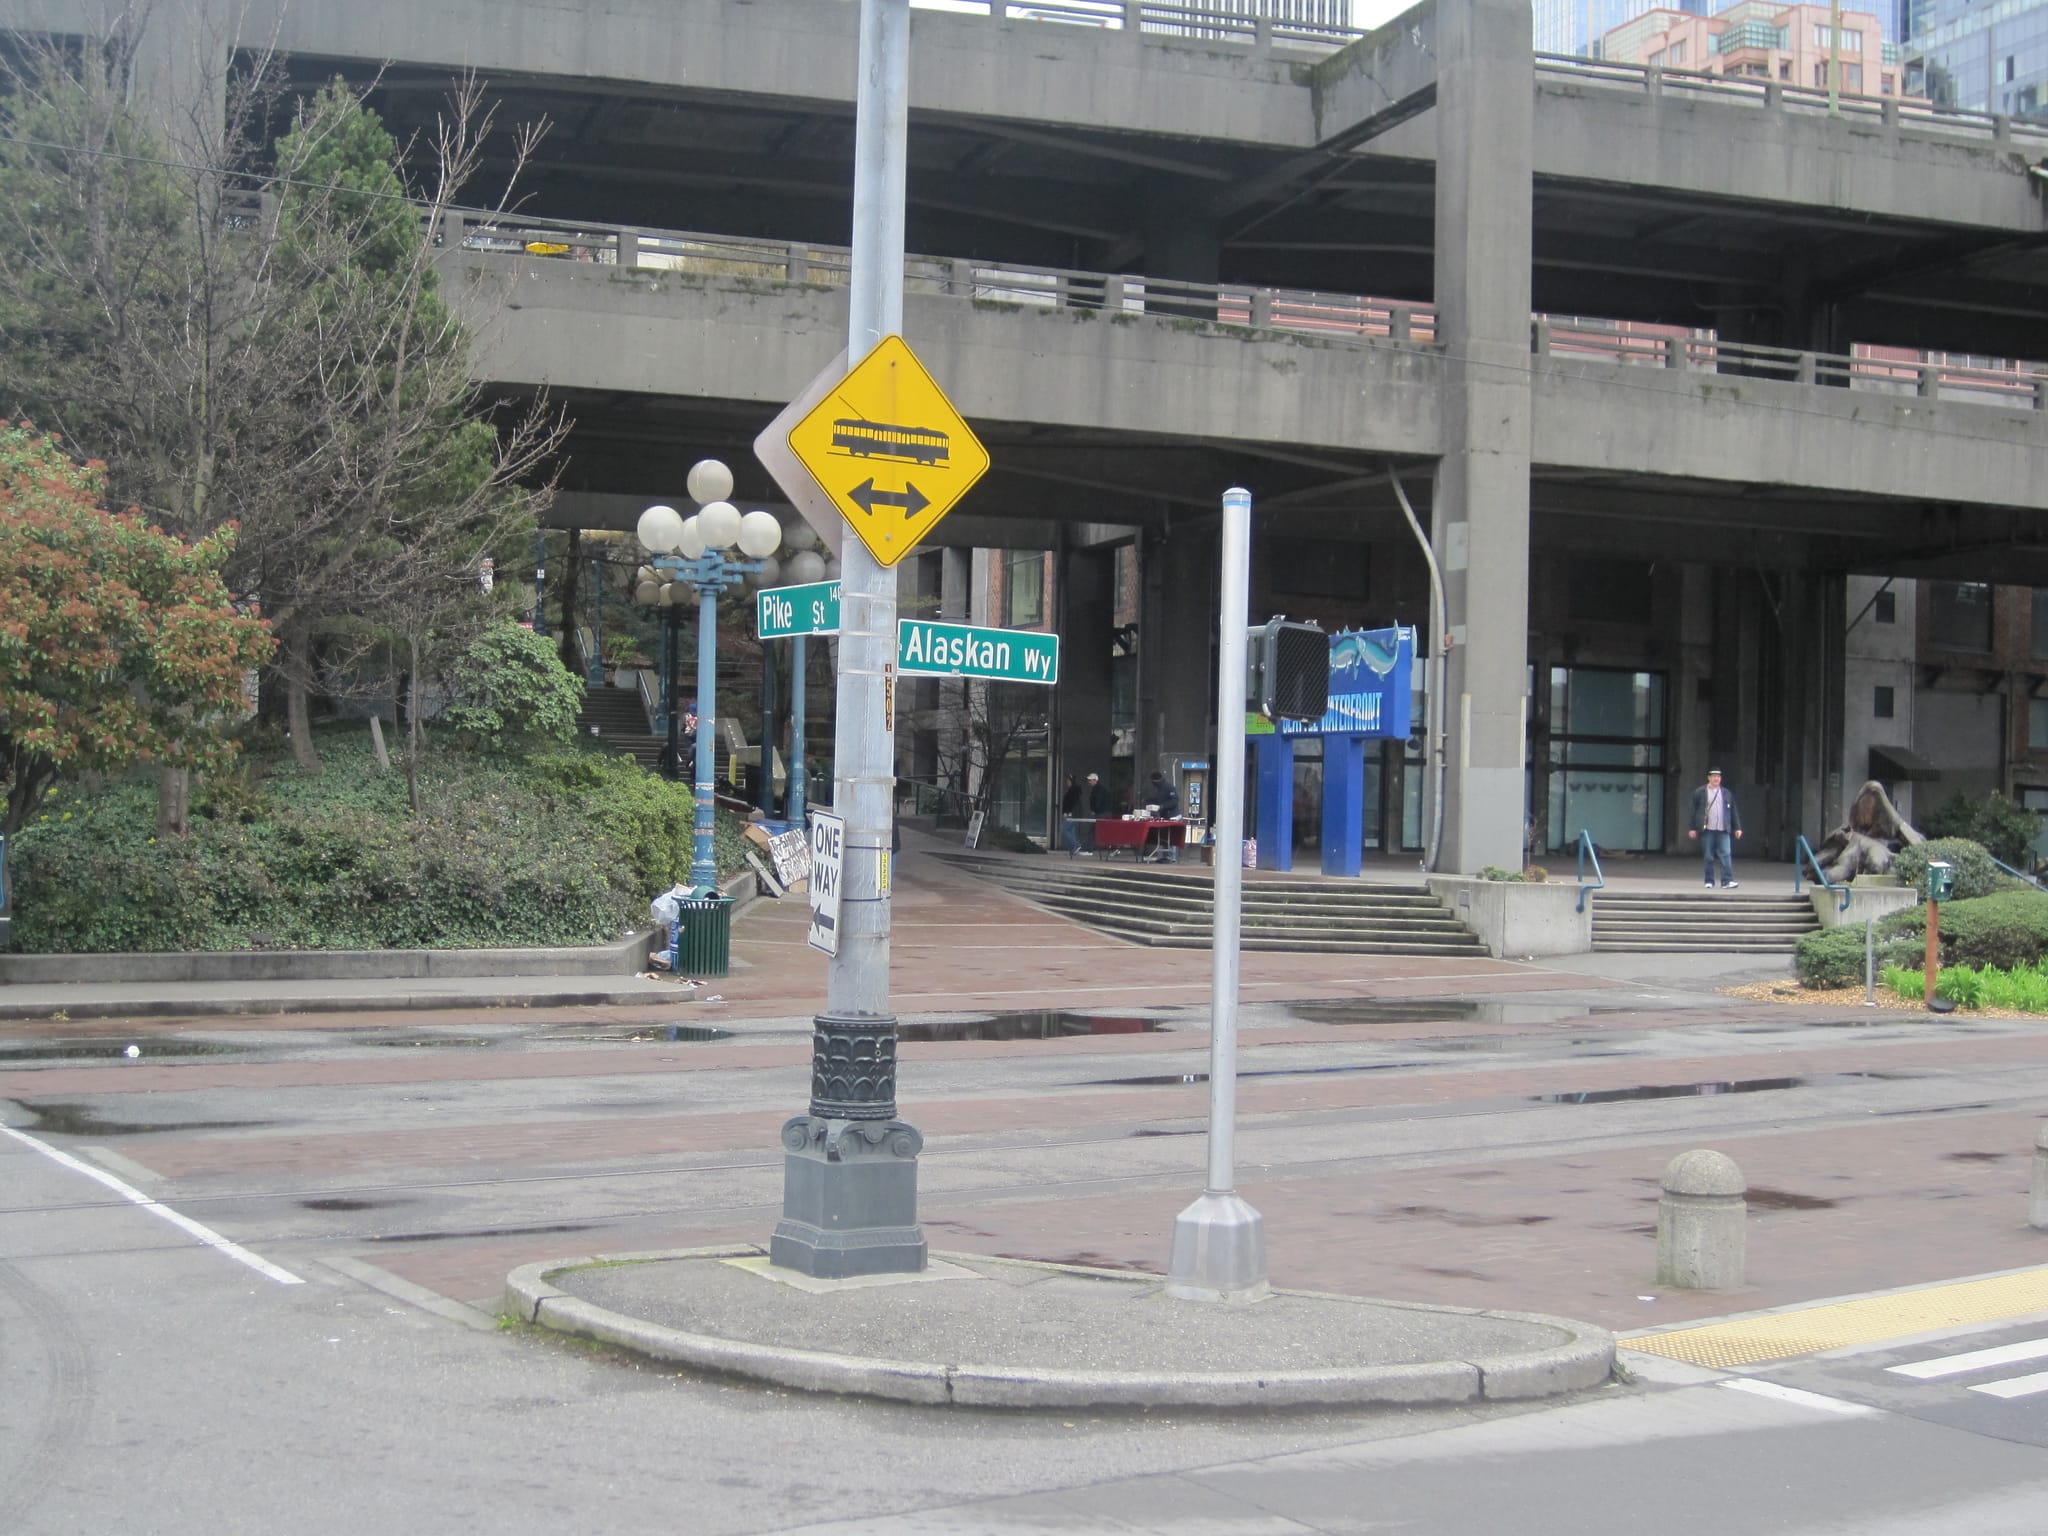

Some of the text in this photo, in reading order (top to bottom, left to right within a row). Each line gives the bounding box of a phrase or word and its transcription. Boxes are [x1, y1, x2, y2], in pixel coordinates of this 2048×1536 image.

[763, 595, 825, 631] Pike St
[905, 625, 1052, 679] Alaskan Wy
[1321, 692, 1383, 732] WATERFRONT
[815, 823, 840, 859] ONE
[814, 861, 839, 898] WAY
